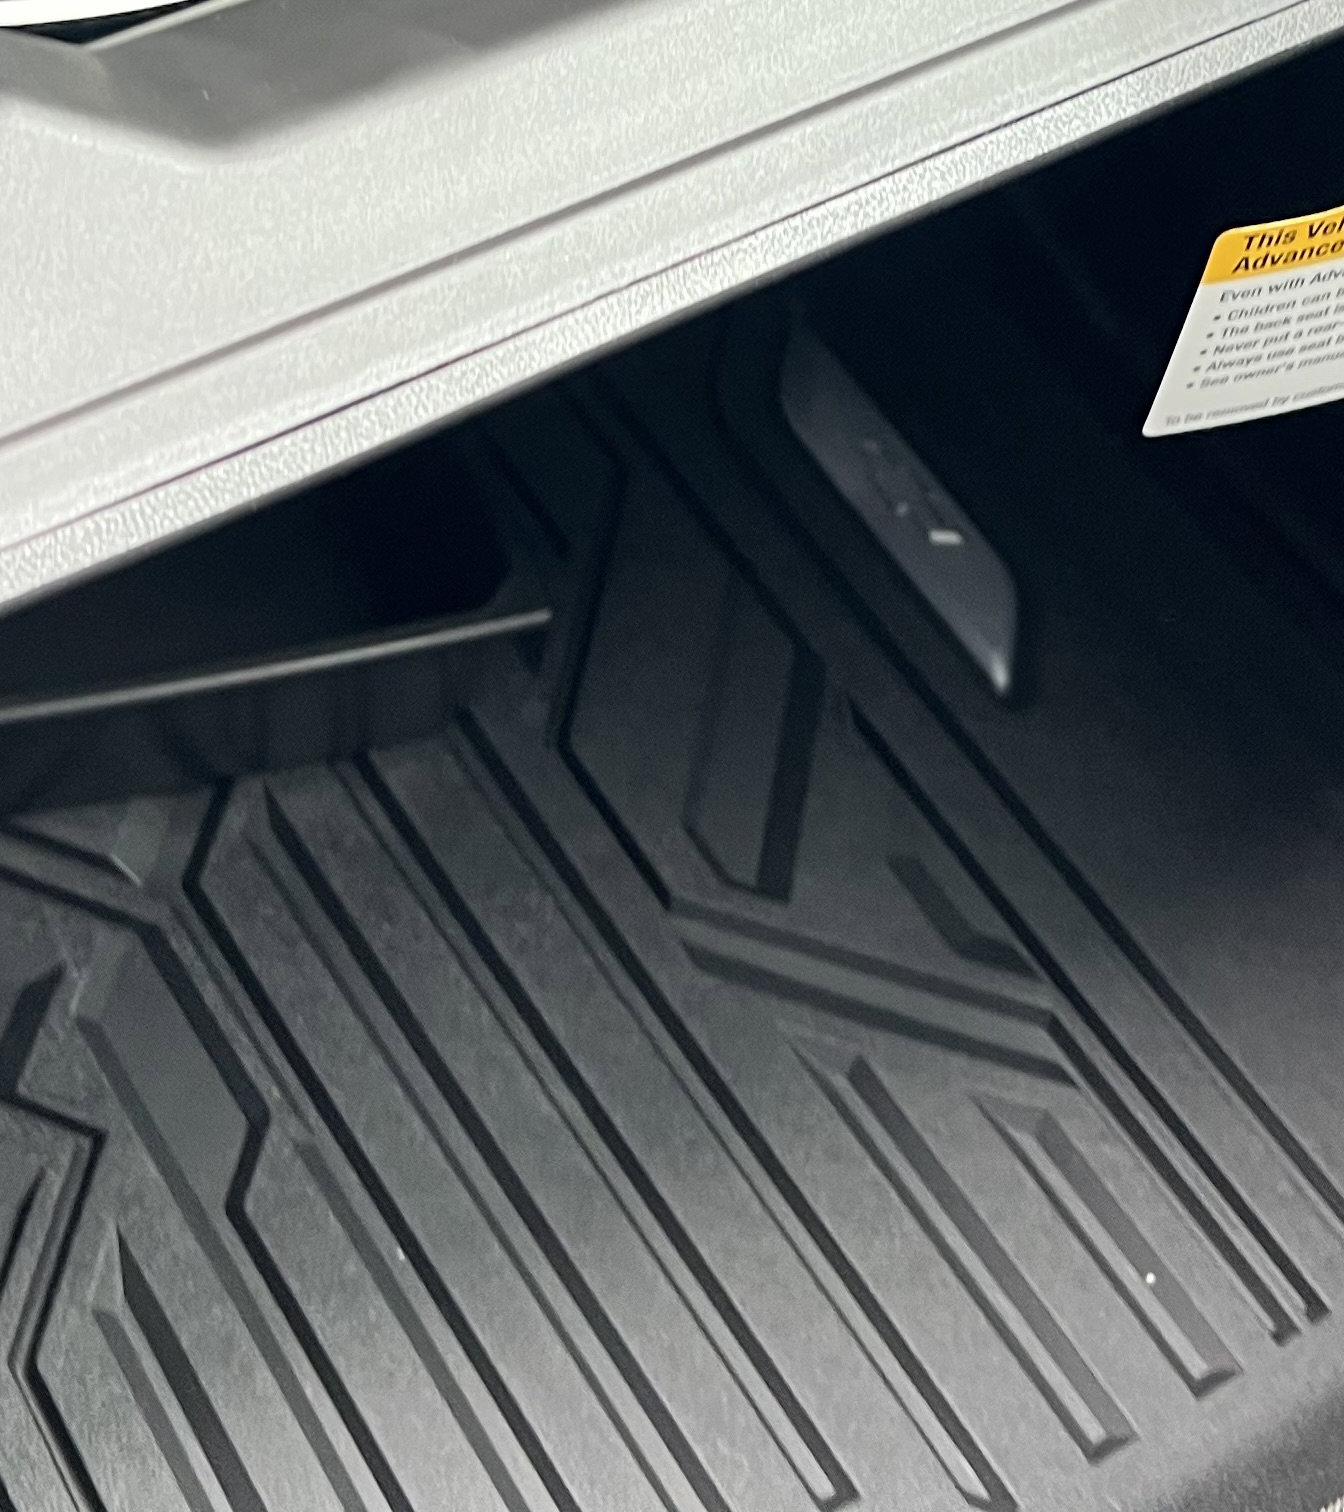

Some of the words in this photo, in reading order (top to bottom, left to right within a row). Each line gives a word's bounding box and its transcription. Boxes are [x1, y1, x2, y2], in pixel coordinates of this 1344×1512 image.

[1244, 228, 1297, 251] This
[1219, 287, 1262, 303] Even
[1269, 277, 1305, 293] with
[1228, 300, 1297, 321] Children
[1301, 292, 1332, 307] can
[1222, 325, 1249, 339] The
[1254, 316, 1291, 333] back
[1296, 306, 1330, 323] seat
[1206, 354, 1263, 372] Always
[1267, 349, 1295, 361] use
[1299, 338, 1332, 354] seat
[1213, 339, 1260, 356] Never
[1263, 332, 1290, 348] put
[1200, 374, 1230, 389] See
[1233, 361, 1294, 382] owner's
